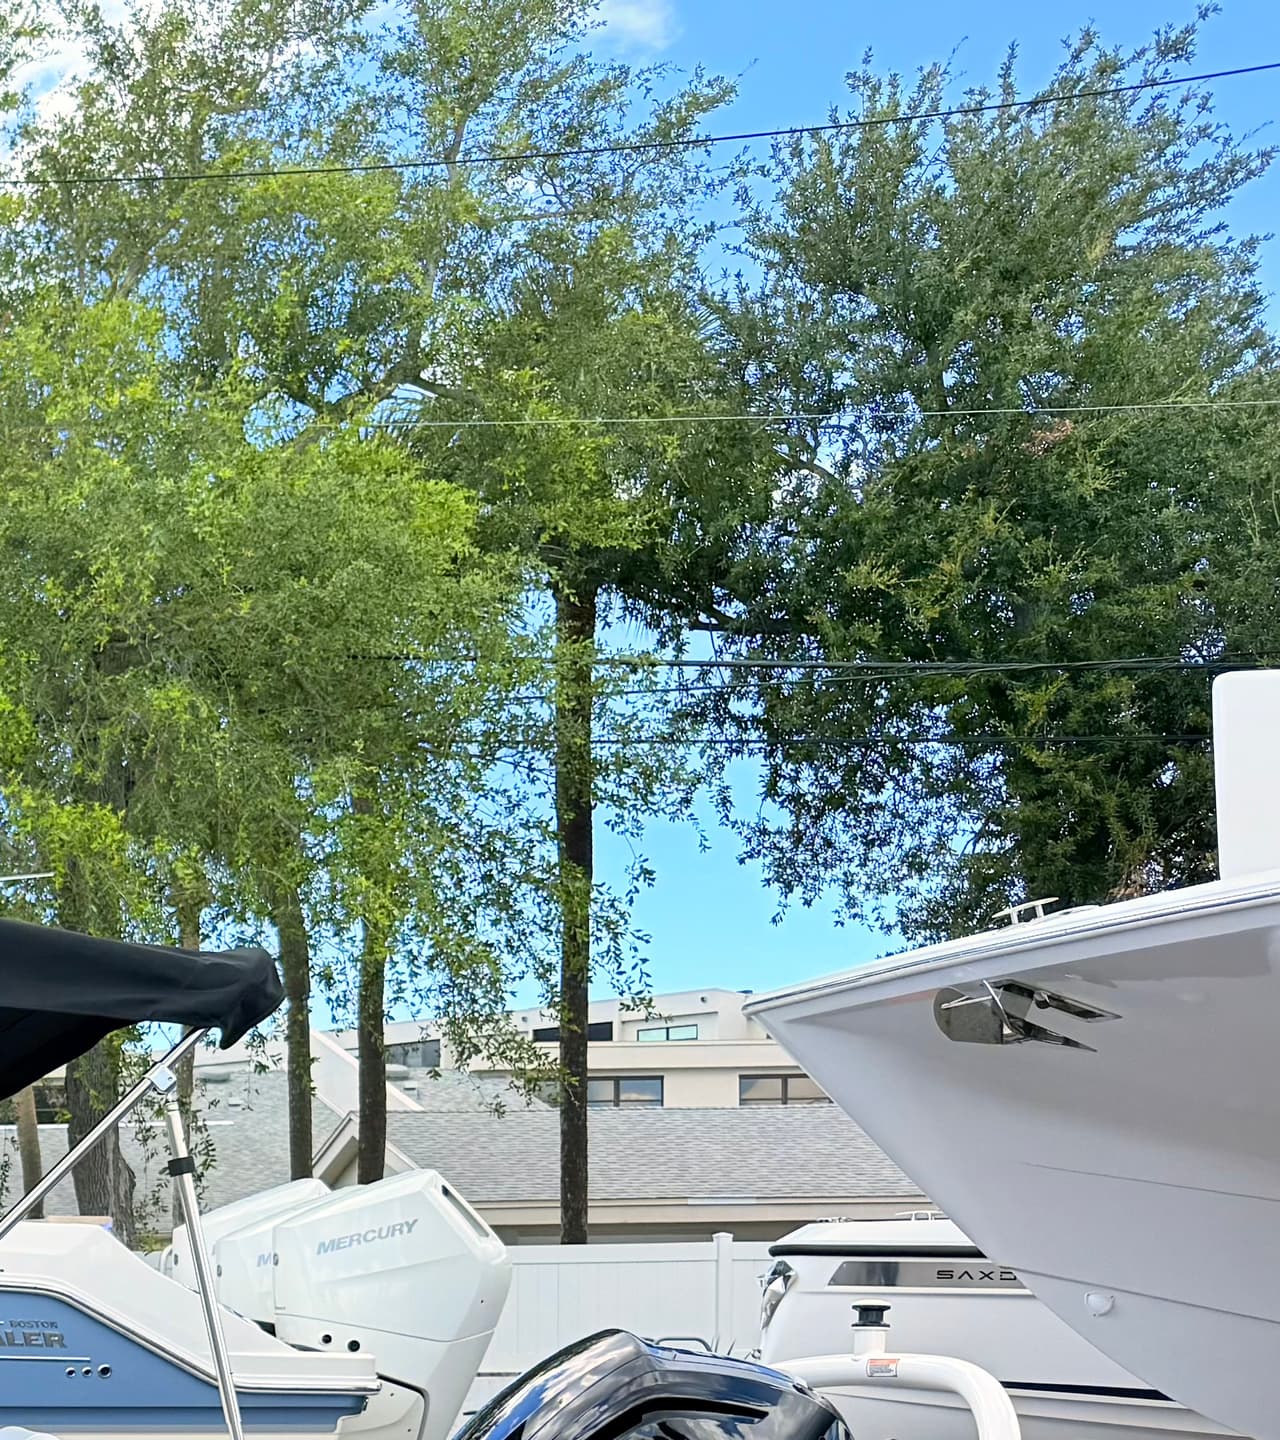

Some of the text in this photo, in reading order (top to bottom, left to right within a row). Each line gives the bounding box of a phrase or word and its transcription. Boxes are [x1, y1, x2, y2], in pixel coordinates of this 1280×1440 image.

[316, 1218, 419, 1255] MERCURY
[936, 1269, 1017, 1281] SAXD
[9, 1319, 58, 1329] BOSTON
